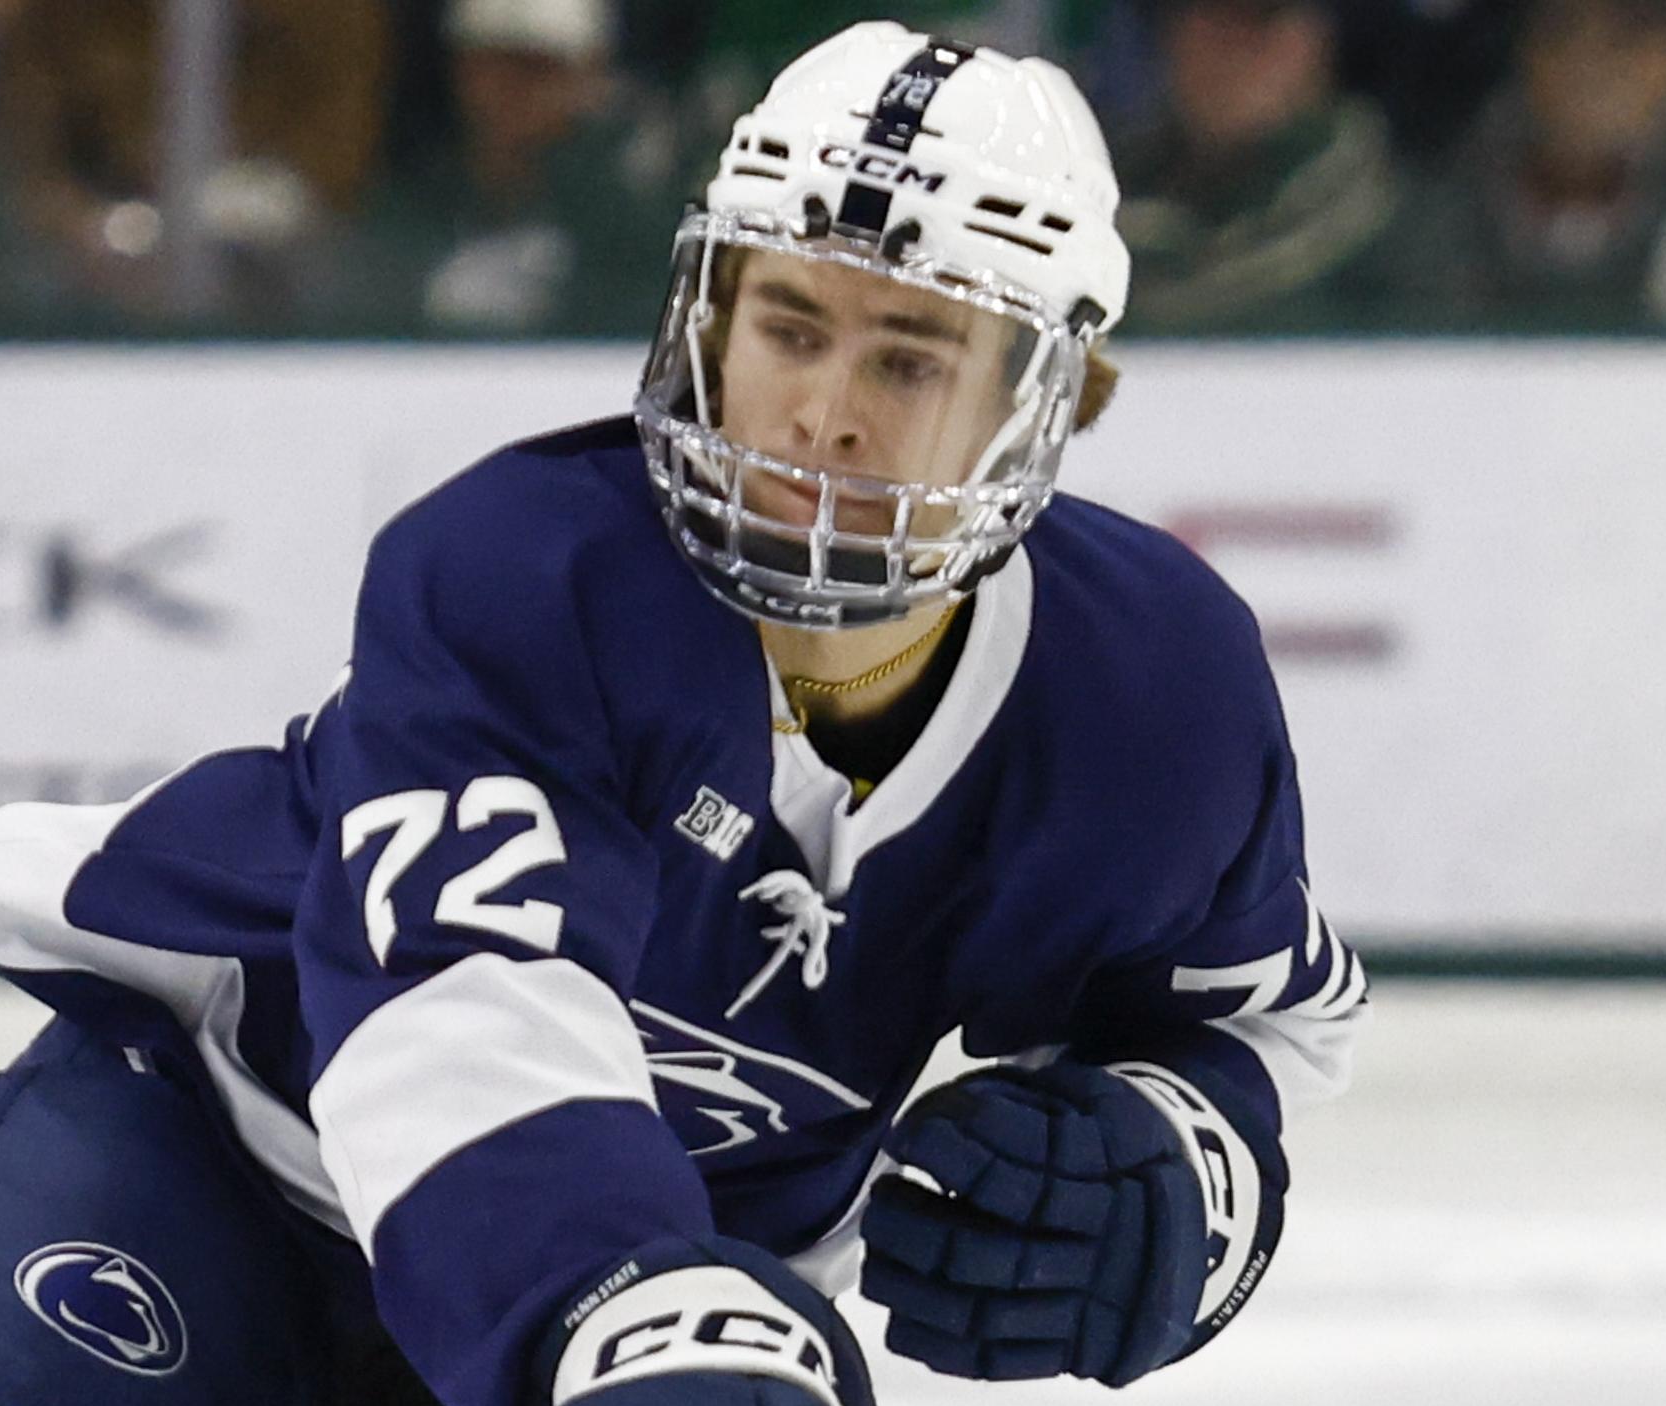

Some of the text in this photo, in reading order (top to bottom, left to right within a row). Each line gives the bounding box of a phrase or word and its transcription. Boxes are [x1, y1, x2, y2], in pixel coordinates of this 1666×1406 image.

[818, 143, 947, 193] CCM
[342, 775, 567, 968] 72
[597, 1259, 641, 1300] STATE
[1239, 1249, 1269, 1293] PENN
